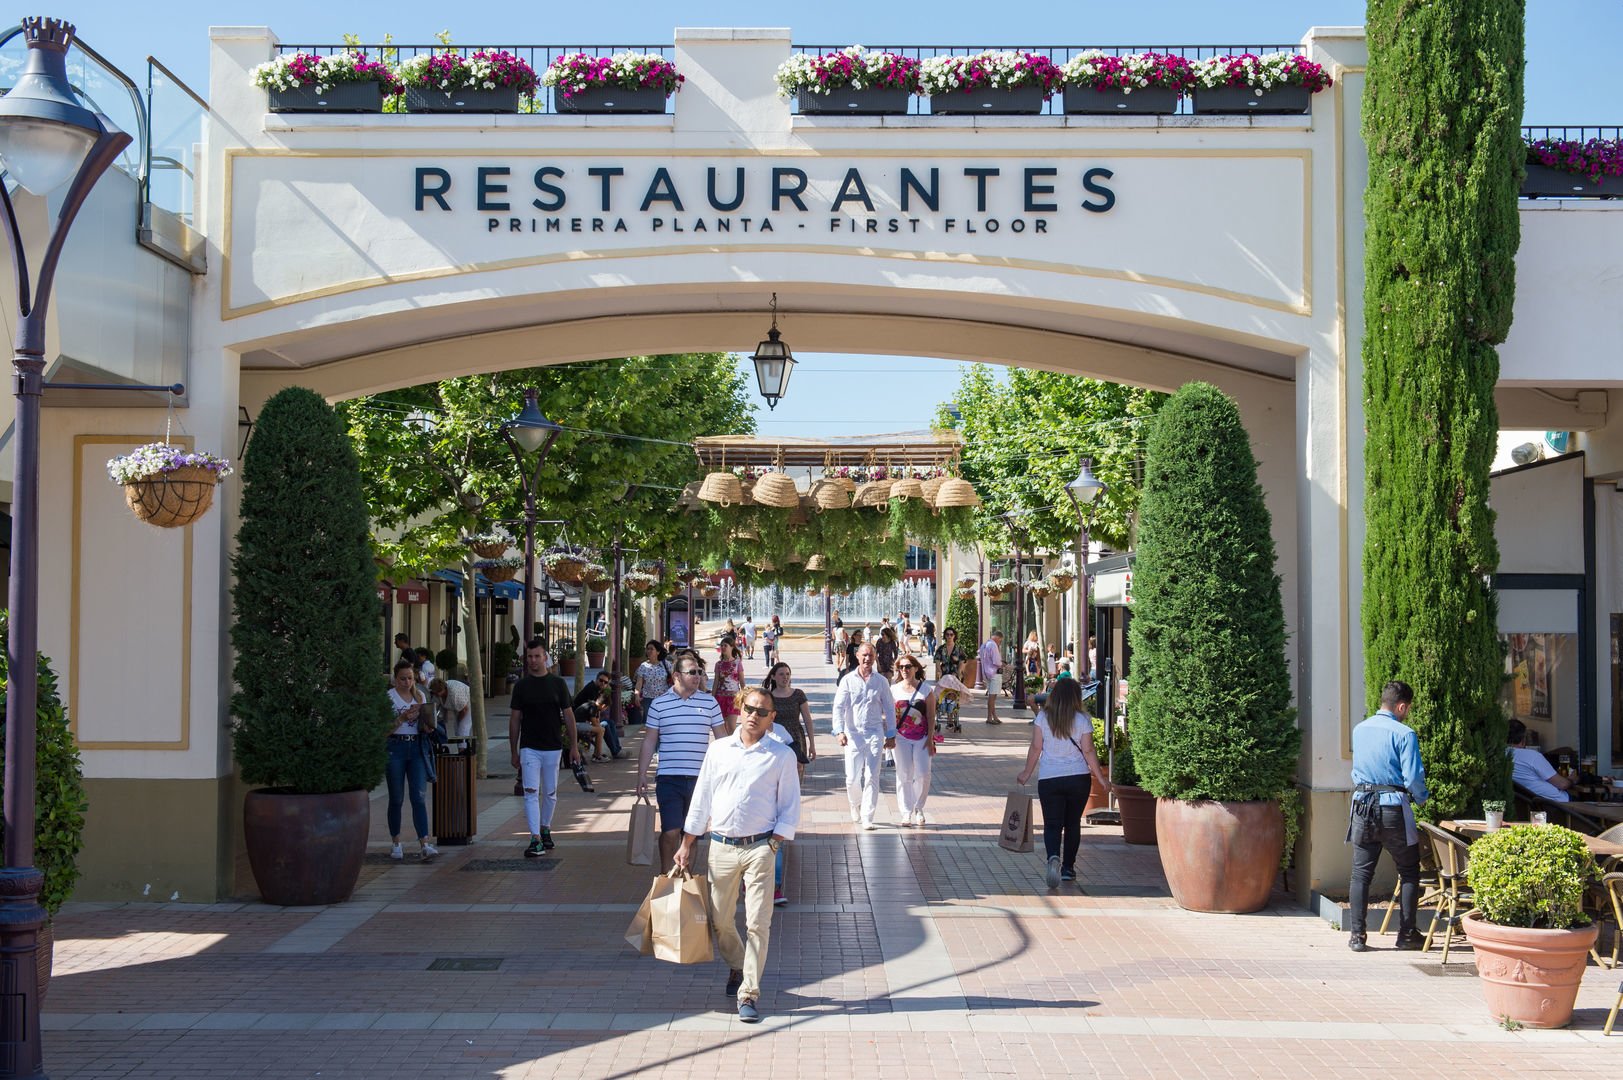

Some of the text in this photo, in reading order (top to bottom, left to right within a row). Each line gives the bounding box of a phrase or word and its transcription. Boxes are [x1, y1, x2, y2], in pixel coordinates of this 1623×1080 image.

[415, 167, 1116, 212] RESTAURANTES
[488, 217, 628, 234] PRIMERA
[652, 217, 774, 234] PLANTA
[830, 218, 921, 234] FIRST
[945, 218, 1048, 234] FLOOR
